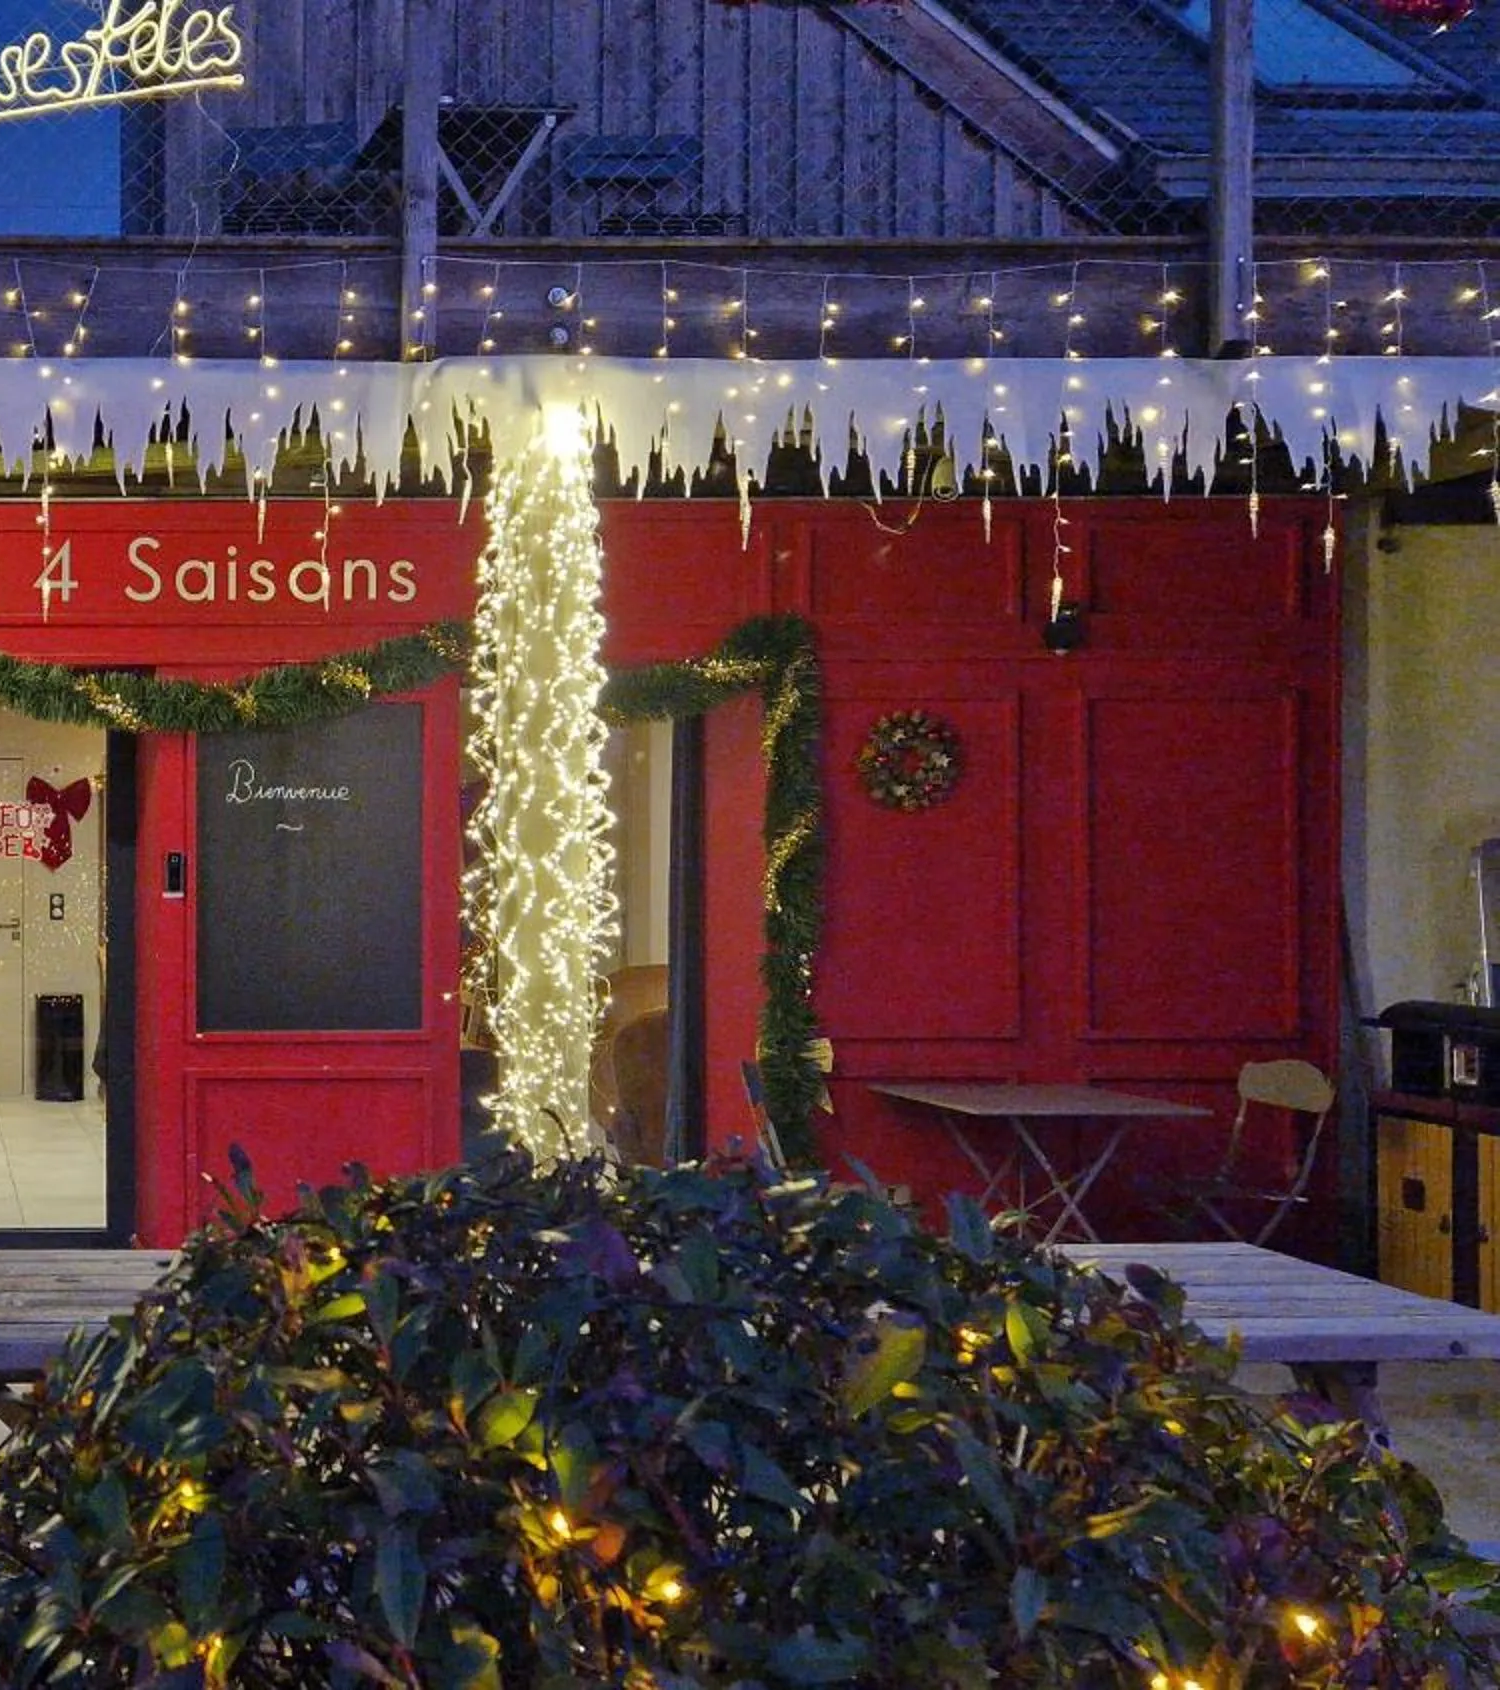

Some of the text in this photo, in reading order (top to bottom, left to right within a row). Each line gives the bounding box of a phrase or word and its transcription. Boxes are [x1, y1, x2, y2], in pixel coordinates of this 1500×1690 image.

[33, 538, 79, 602] 4
[124, 536, 418, 603] Saisons
[226, 759, 350, 803] Bienvenue
